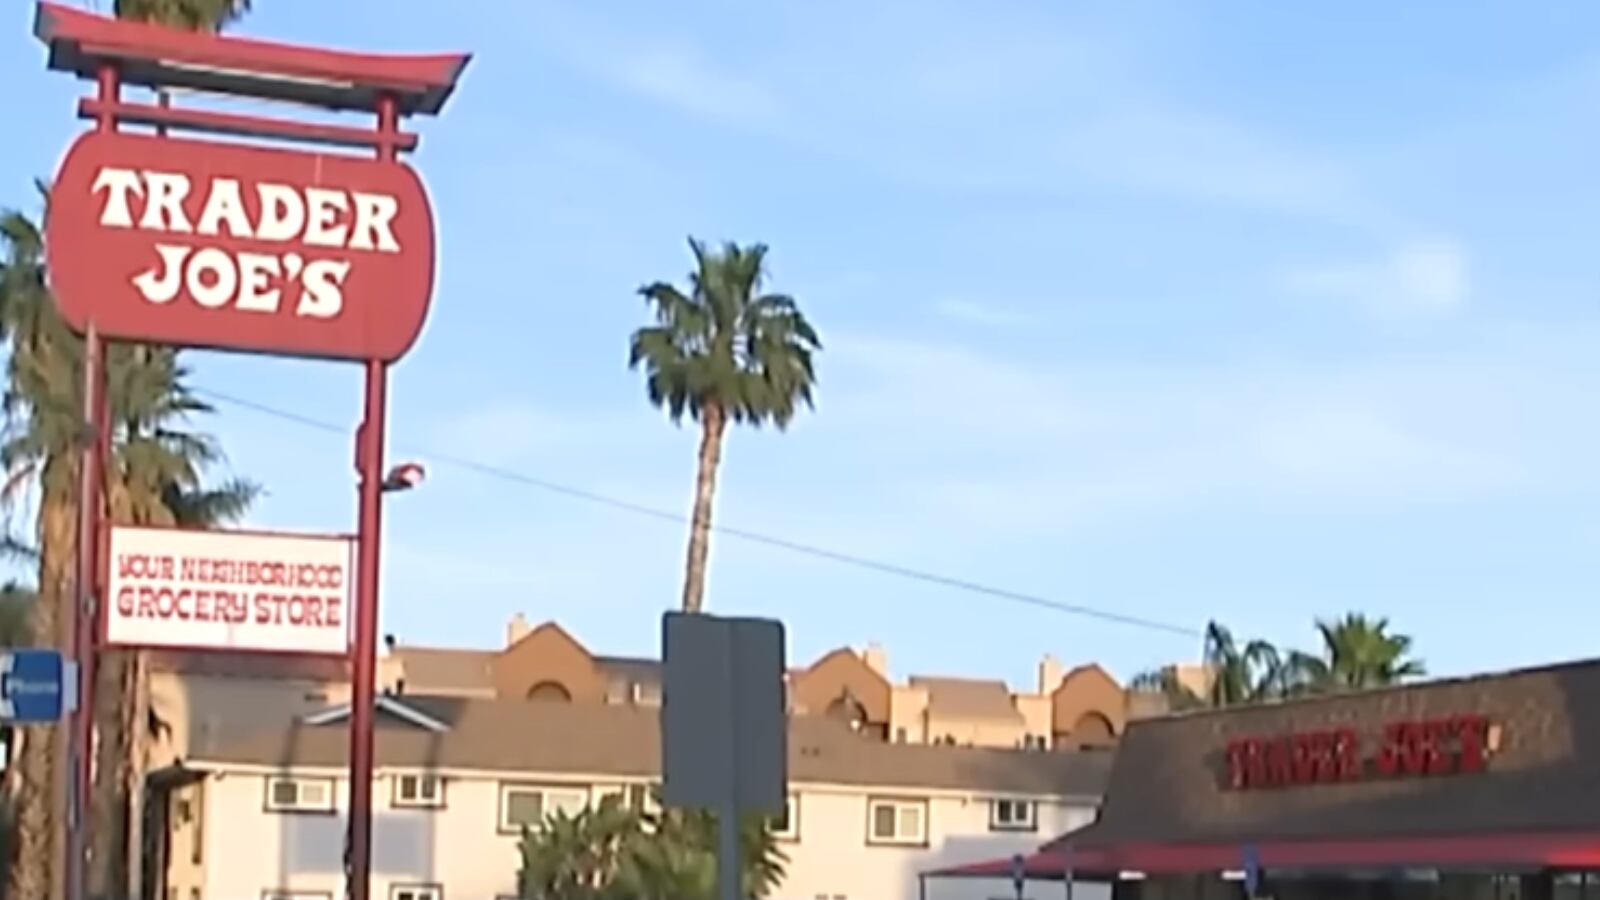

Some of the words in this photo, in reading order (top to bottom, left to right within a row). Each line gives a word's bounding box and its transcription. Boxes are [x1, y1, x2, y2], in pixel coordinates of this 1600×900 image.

[91, 167, 401, 253] TRADER
[131, 243, 351, 318] JOE'S
[118, 554, 174, 580] YOUR
[180, 557, 343, 588] NEIGHBORHOOD
[117, 586, 248, 623] GROCERY
[254, 593, 342, 627] STORE
[1225, 729, 1357, 790] TRADER
